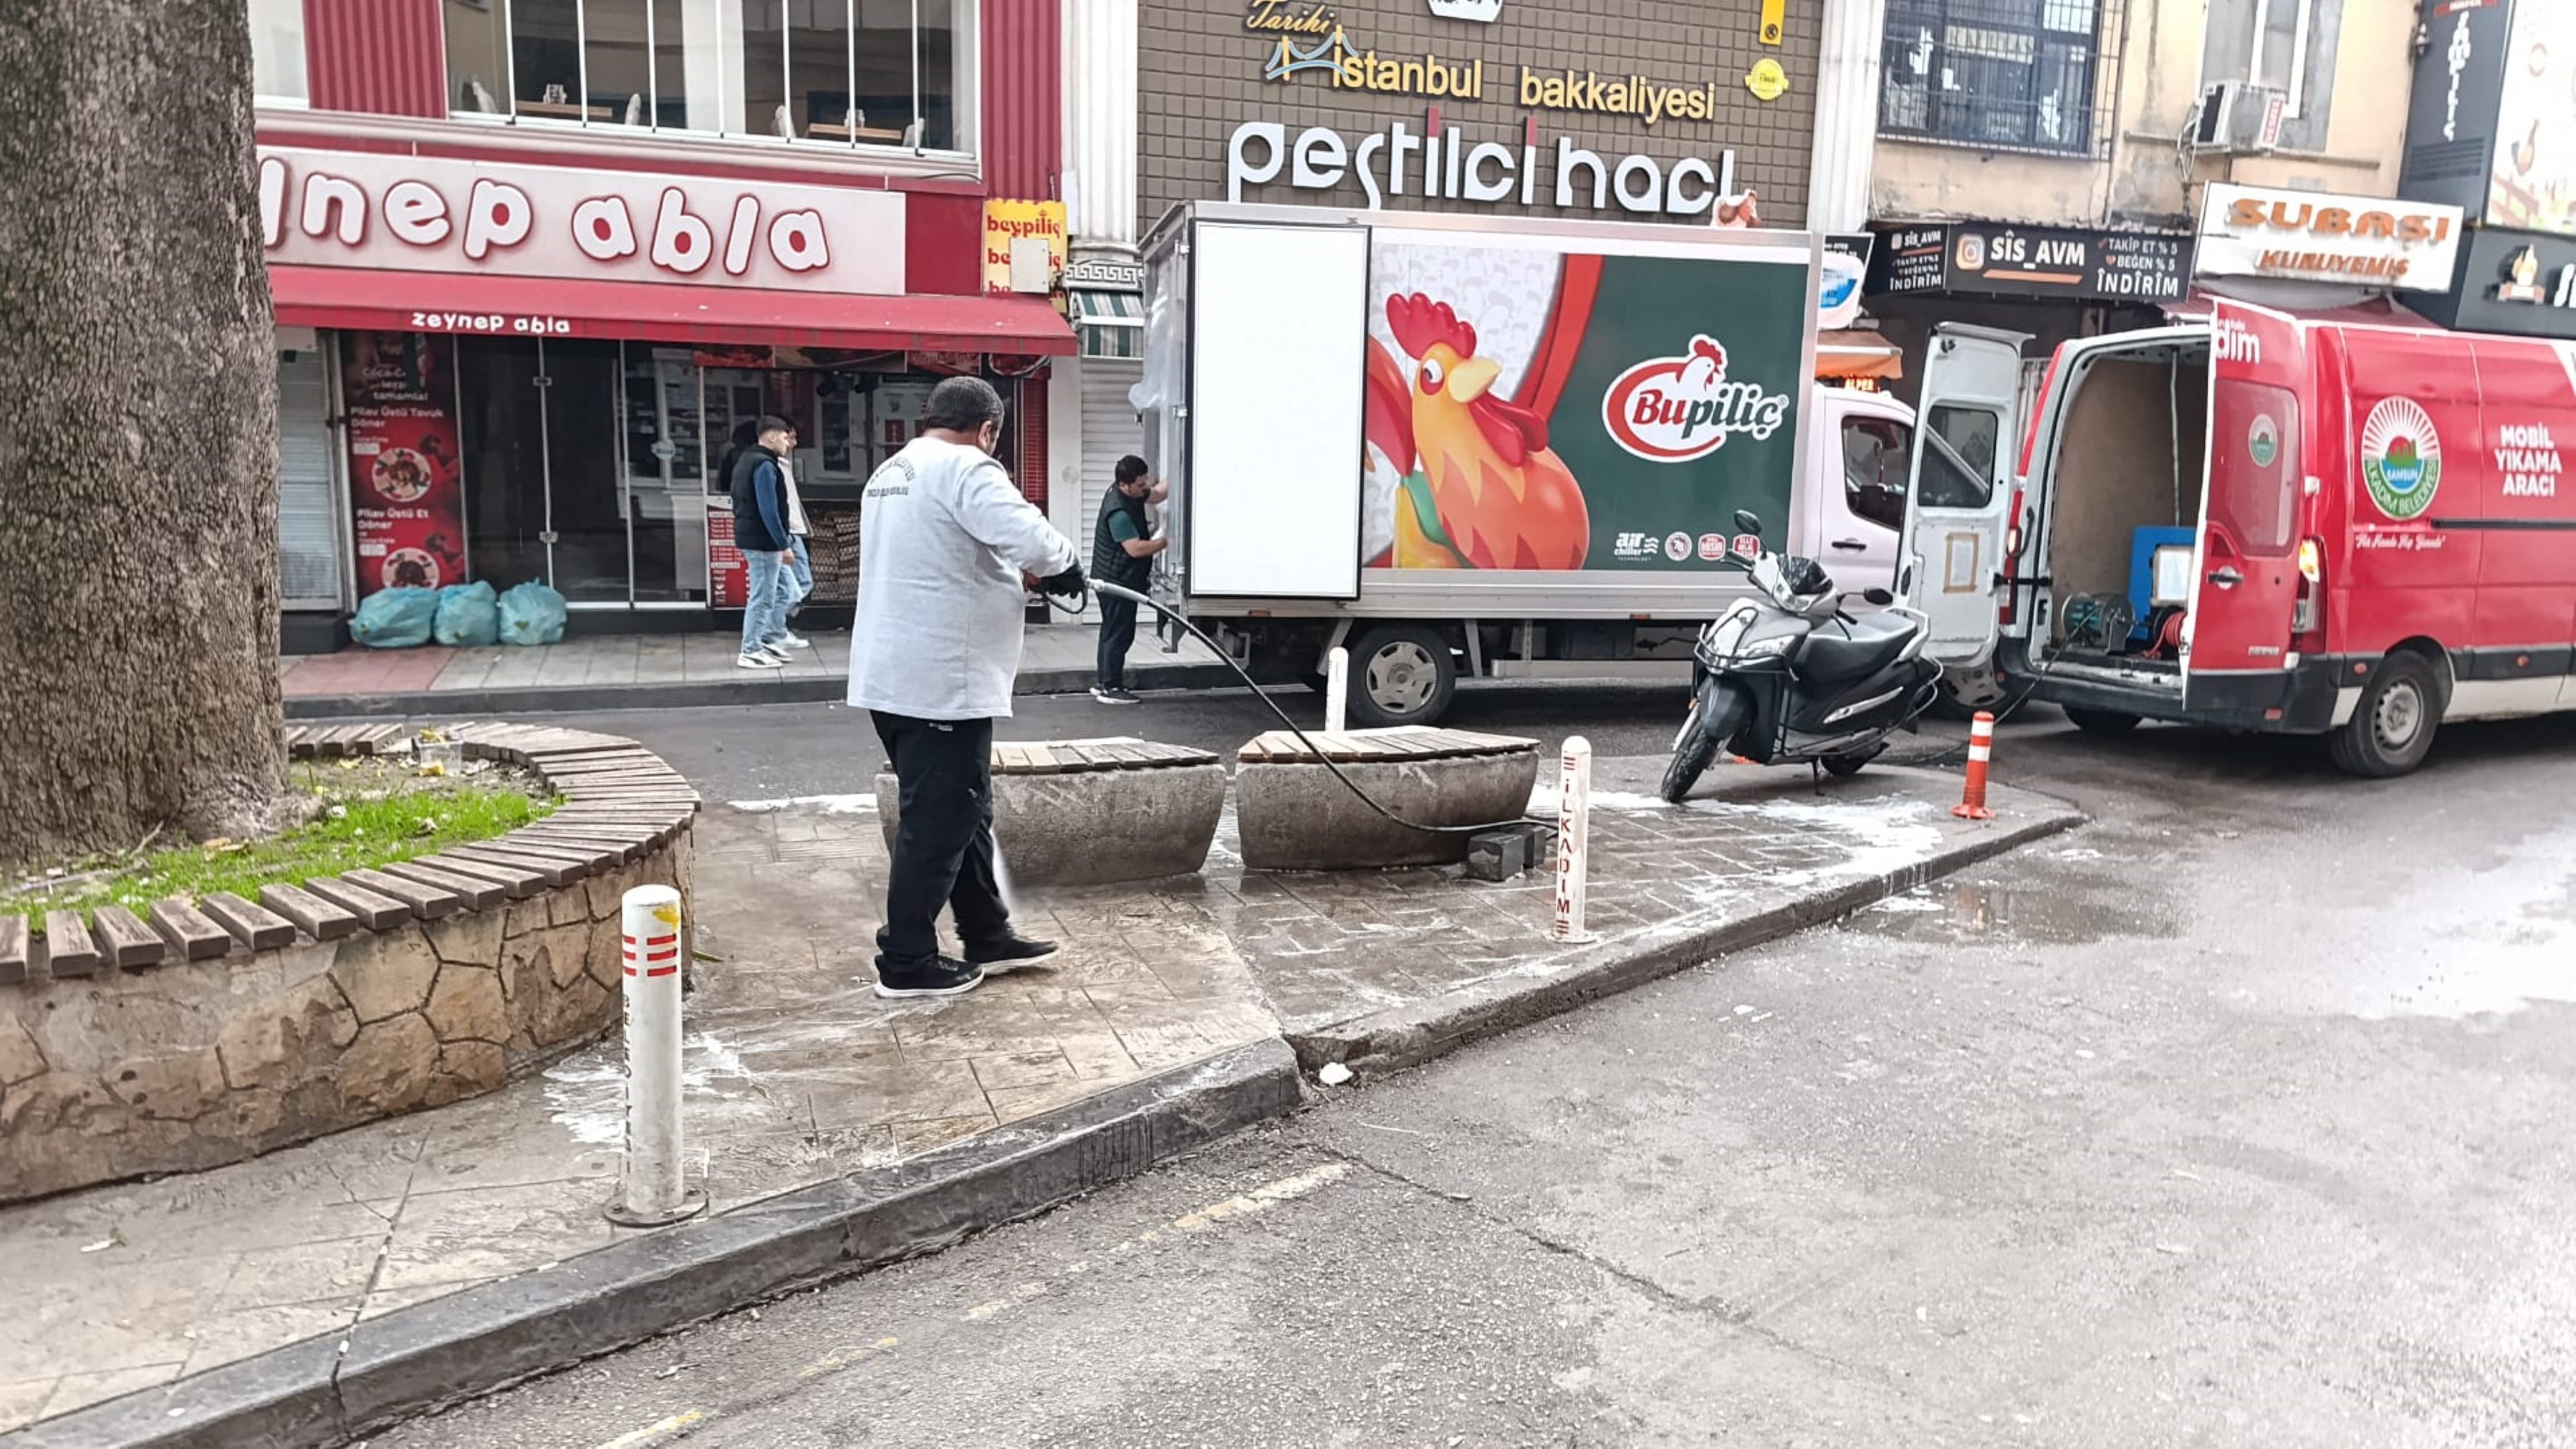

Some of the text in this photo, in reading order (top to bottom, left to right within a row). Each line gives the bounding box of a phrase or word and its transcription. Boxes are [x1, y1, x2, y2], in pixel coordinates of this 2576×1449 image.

[1246, 0, 1336, 34] Tarihi
[1521, 66, 1715, 125] bakkaliyesi
[572, 186, 830, 275] abla
[987, 215, 1061, 238] beypiliç
[2229, 199, 2450, 250] SUBAŞI
[2109, 236, 2140, 254] TAKİP
[2142, 240, 2157, 254] ET
[2117, 254, 2154, 270] BEĞEN
[1889, 273, 1942, 291] İNDİRİM
[411, 312, 571, 334] zeynep abla
[1632, 384, 1779, 439] Bupiliç
[2501, 421, 2555, 449] MOBİL
[2494, 448, 2563, 473] YIKAMA
[2502, 472, 2555, 497] ARACI
